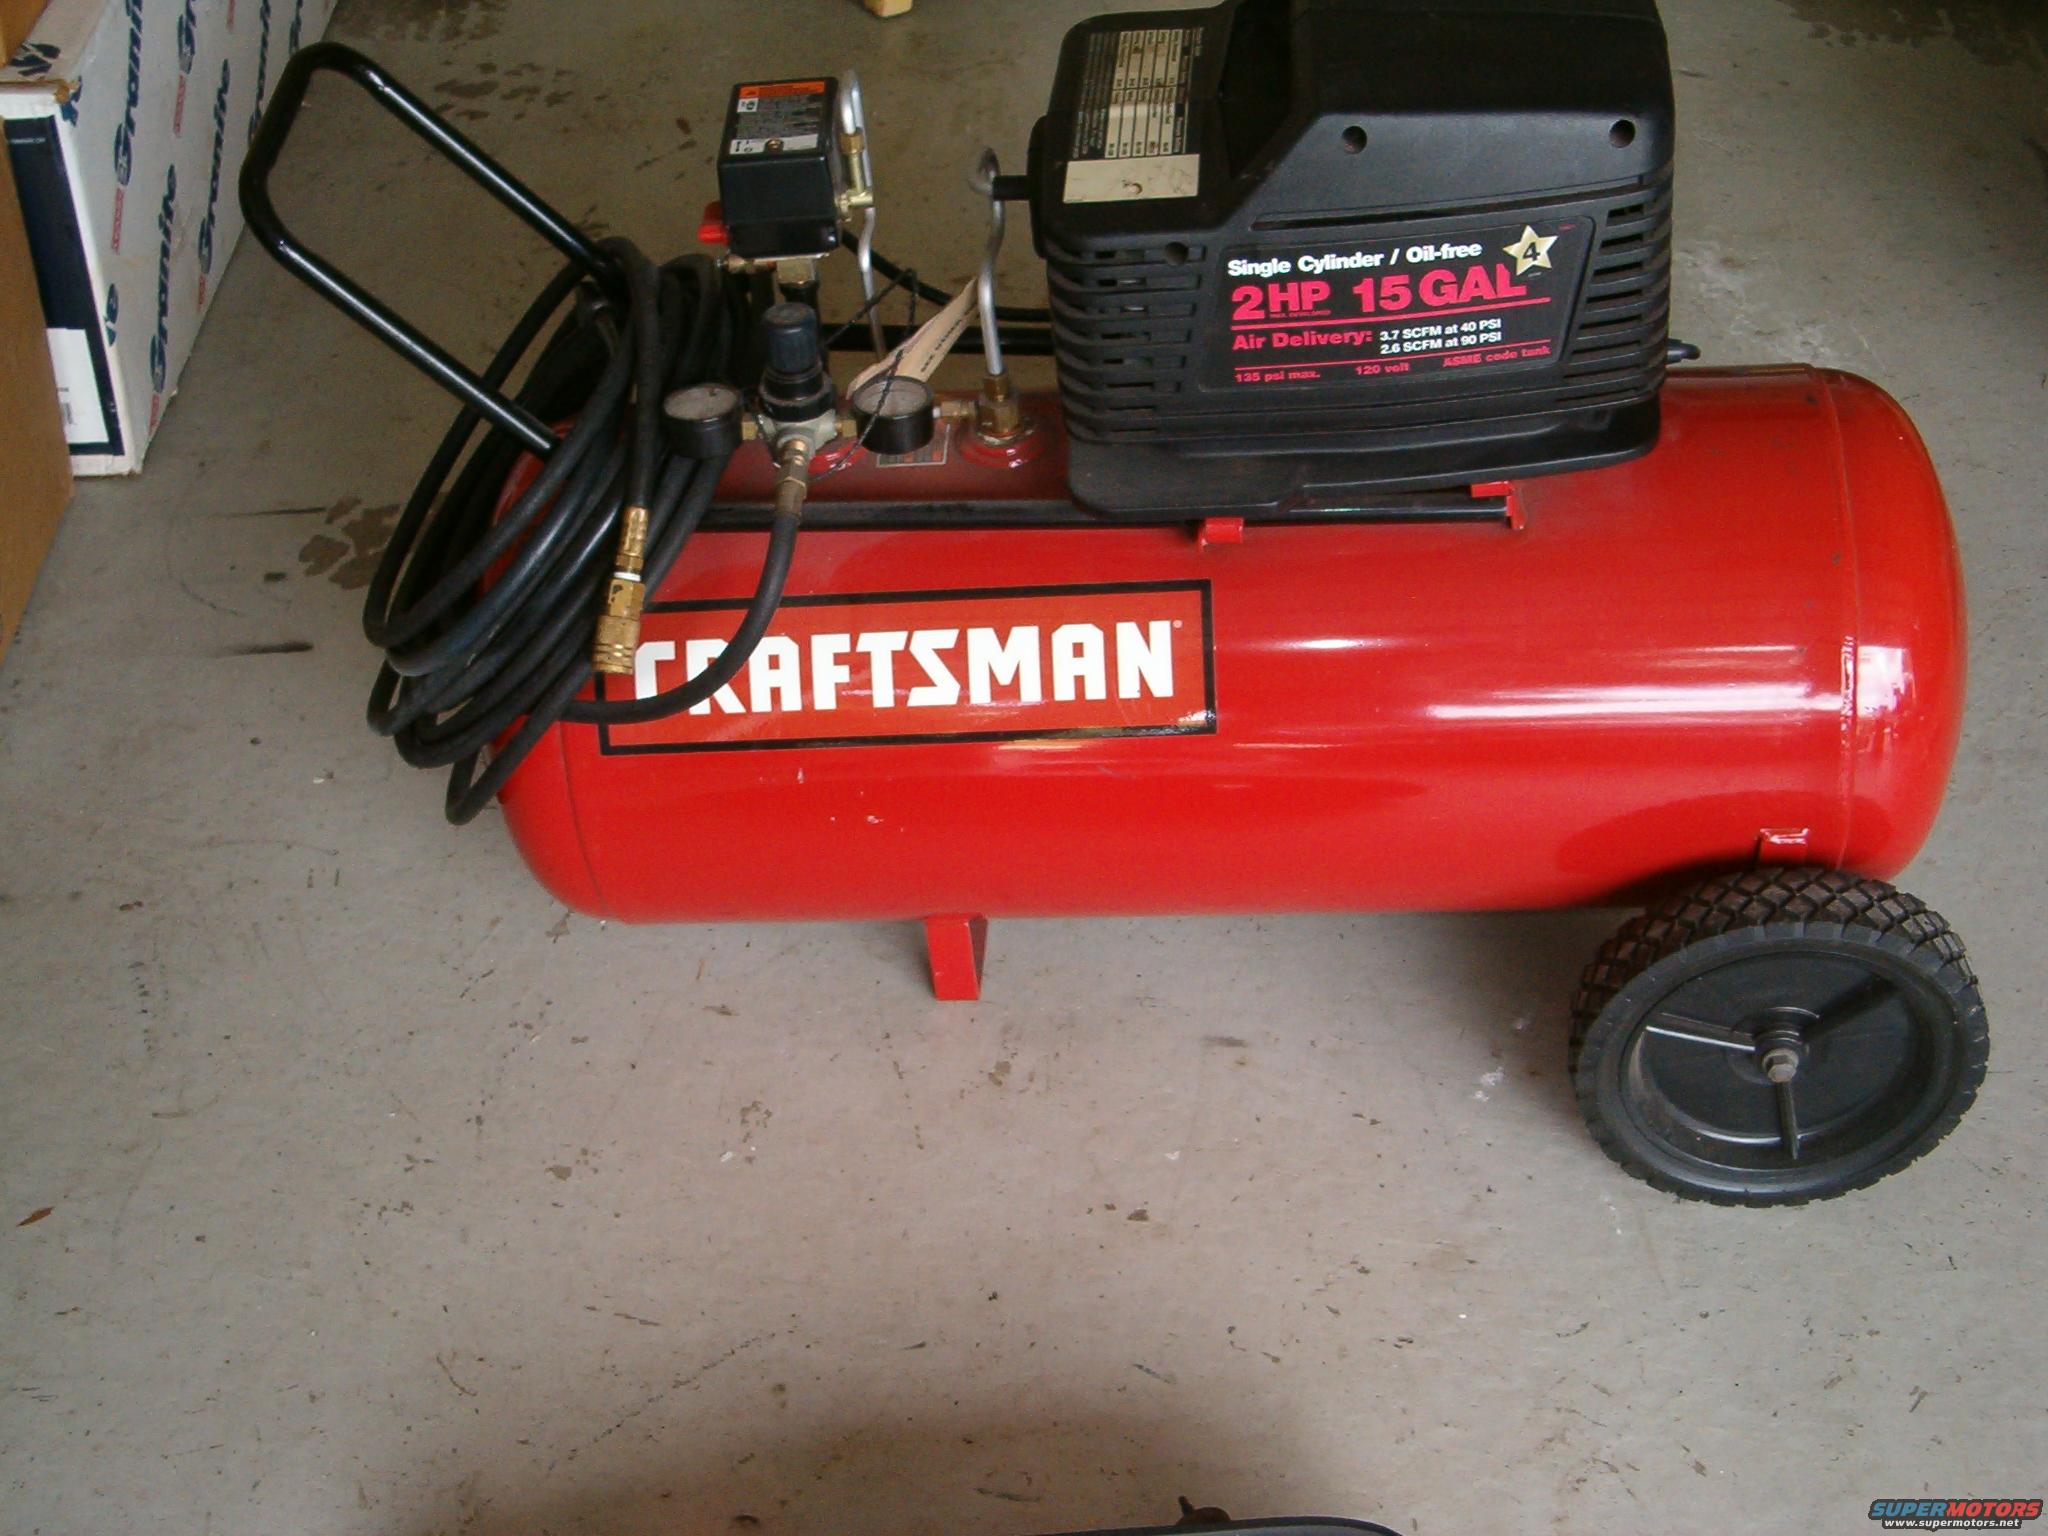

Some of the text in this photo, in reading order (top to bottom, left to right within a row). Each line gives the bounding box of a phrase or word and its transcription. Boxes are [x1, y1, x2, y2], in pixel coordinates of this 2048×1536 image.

[1227, 243, 1484, 278] Single Cylinder / Oil-free
[1522, 241, 1541, 262] 4
[1352, 274, 1413, 313] 15
[1418, 263, 1528, 307] GAL
[1232, 330, 1373, 350] Air Delivery:
[1379, 318, 1502, 342] 3.7 SCFM at 40 PSI
[1380, 342, 1401, 355] 2.6
[1402, 338, 1443, 352] SCFM
[1445, 335, 1459, 348] at
[1480, 331, 1503, 344] PSI
[1235, 372, 1261, 383] 135
[1264, 370, 1285, 383] psi
[1355, 362, 1410, 375] 120 volt
[634, 621, 1174, 716] CRAFTSMAN
